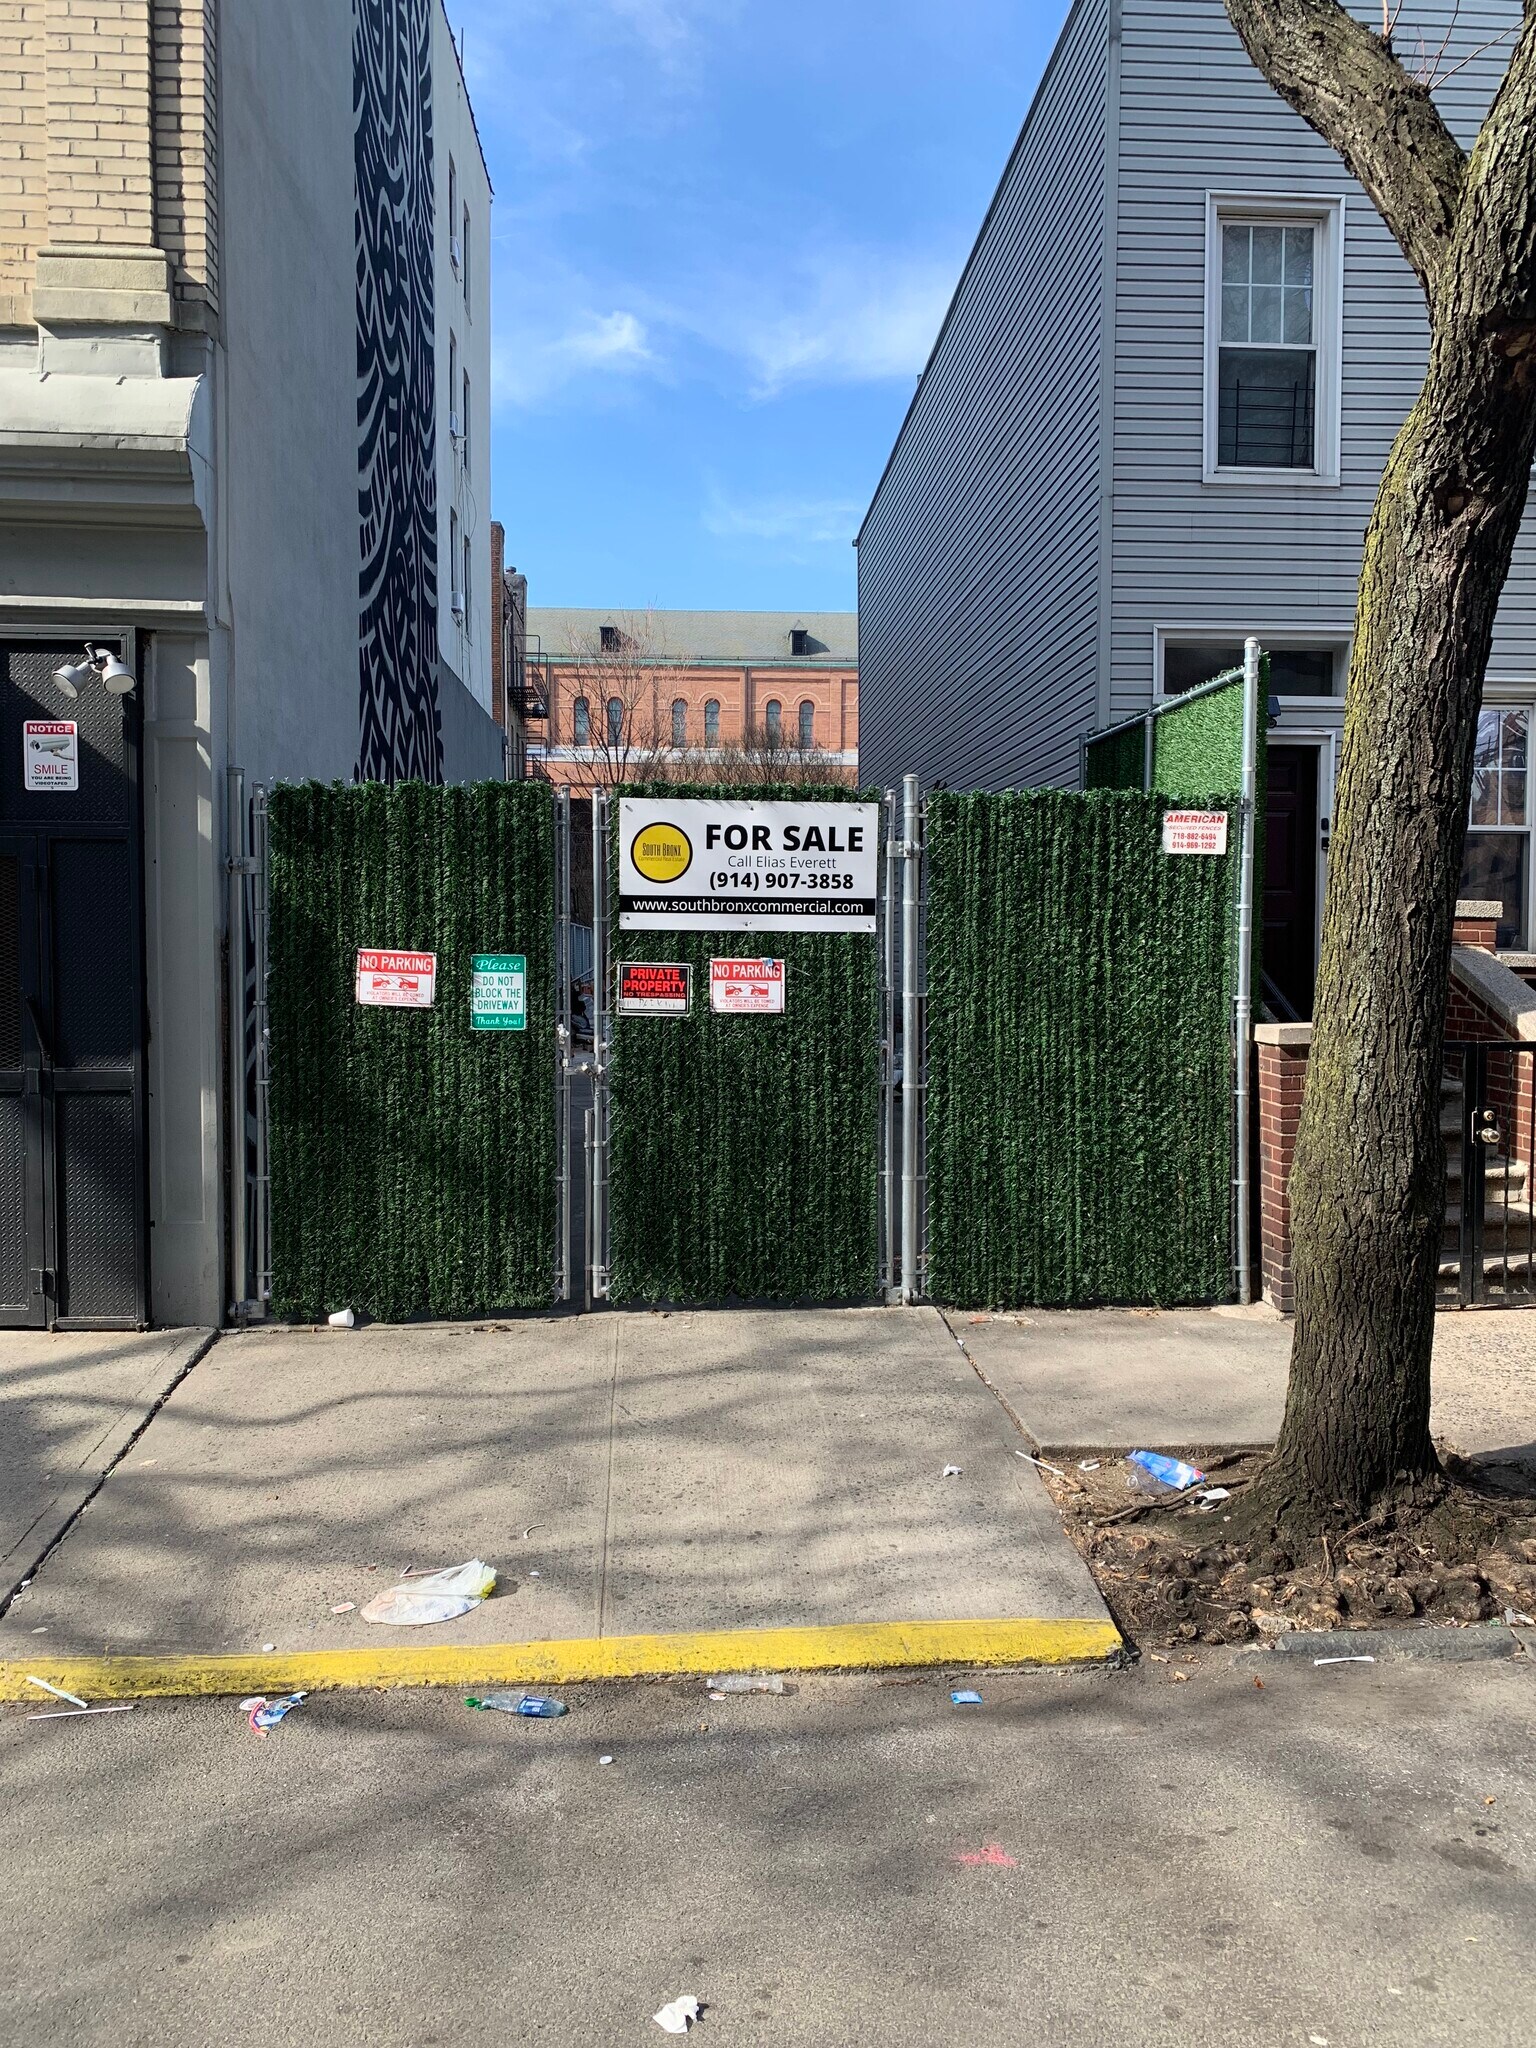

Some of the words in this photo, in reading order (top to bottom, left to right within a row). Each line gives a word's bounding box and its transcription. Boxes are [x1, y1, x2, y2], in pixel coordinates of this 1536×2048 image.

[29, 725, 72, 733] NOTICE
[34, 764, 68, 774] SMILE
[1166, 815, 1225, 823] AMERICAN
[706, 824, 773, 851] FOR
[783, 825, 864, 852] SALE
[642, 843, 660, 856] SOUTH
[662, 843, 681, 856] BRONX
[728, 855, 752, 868] Call
[756, 856, 786, 868] Elias
[790, 857, 837, 869] Everett
[709, 872, 760, 891] (914)
[765, 873, 854, 889] 907-3858
[633, 899, 864, 914] www.southbronxcommercial.com
[361, 955, 378, 969] NO
[380, 956, 432, 971] PARKING
[476, 959, 520, 970] Please
[630, 968, 680, 980] PRIVATE
[713, 964, 730, 978] NO
[732, 964, 781, 979] PARKING
[482, 976, 494, 985] DO
[498, 976, 514, 986] NOT
[623, 980, 686, 992] PROPERTY
[475, 988, 503, 998] BLOCK
[505, 988, 522, 998] THE
[477, 1000, 519, 1009] DRIVEWAY
[476, 1017, 500, 1025] Thank
[502, 1017, 521, 1026] You!
